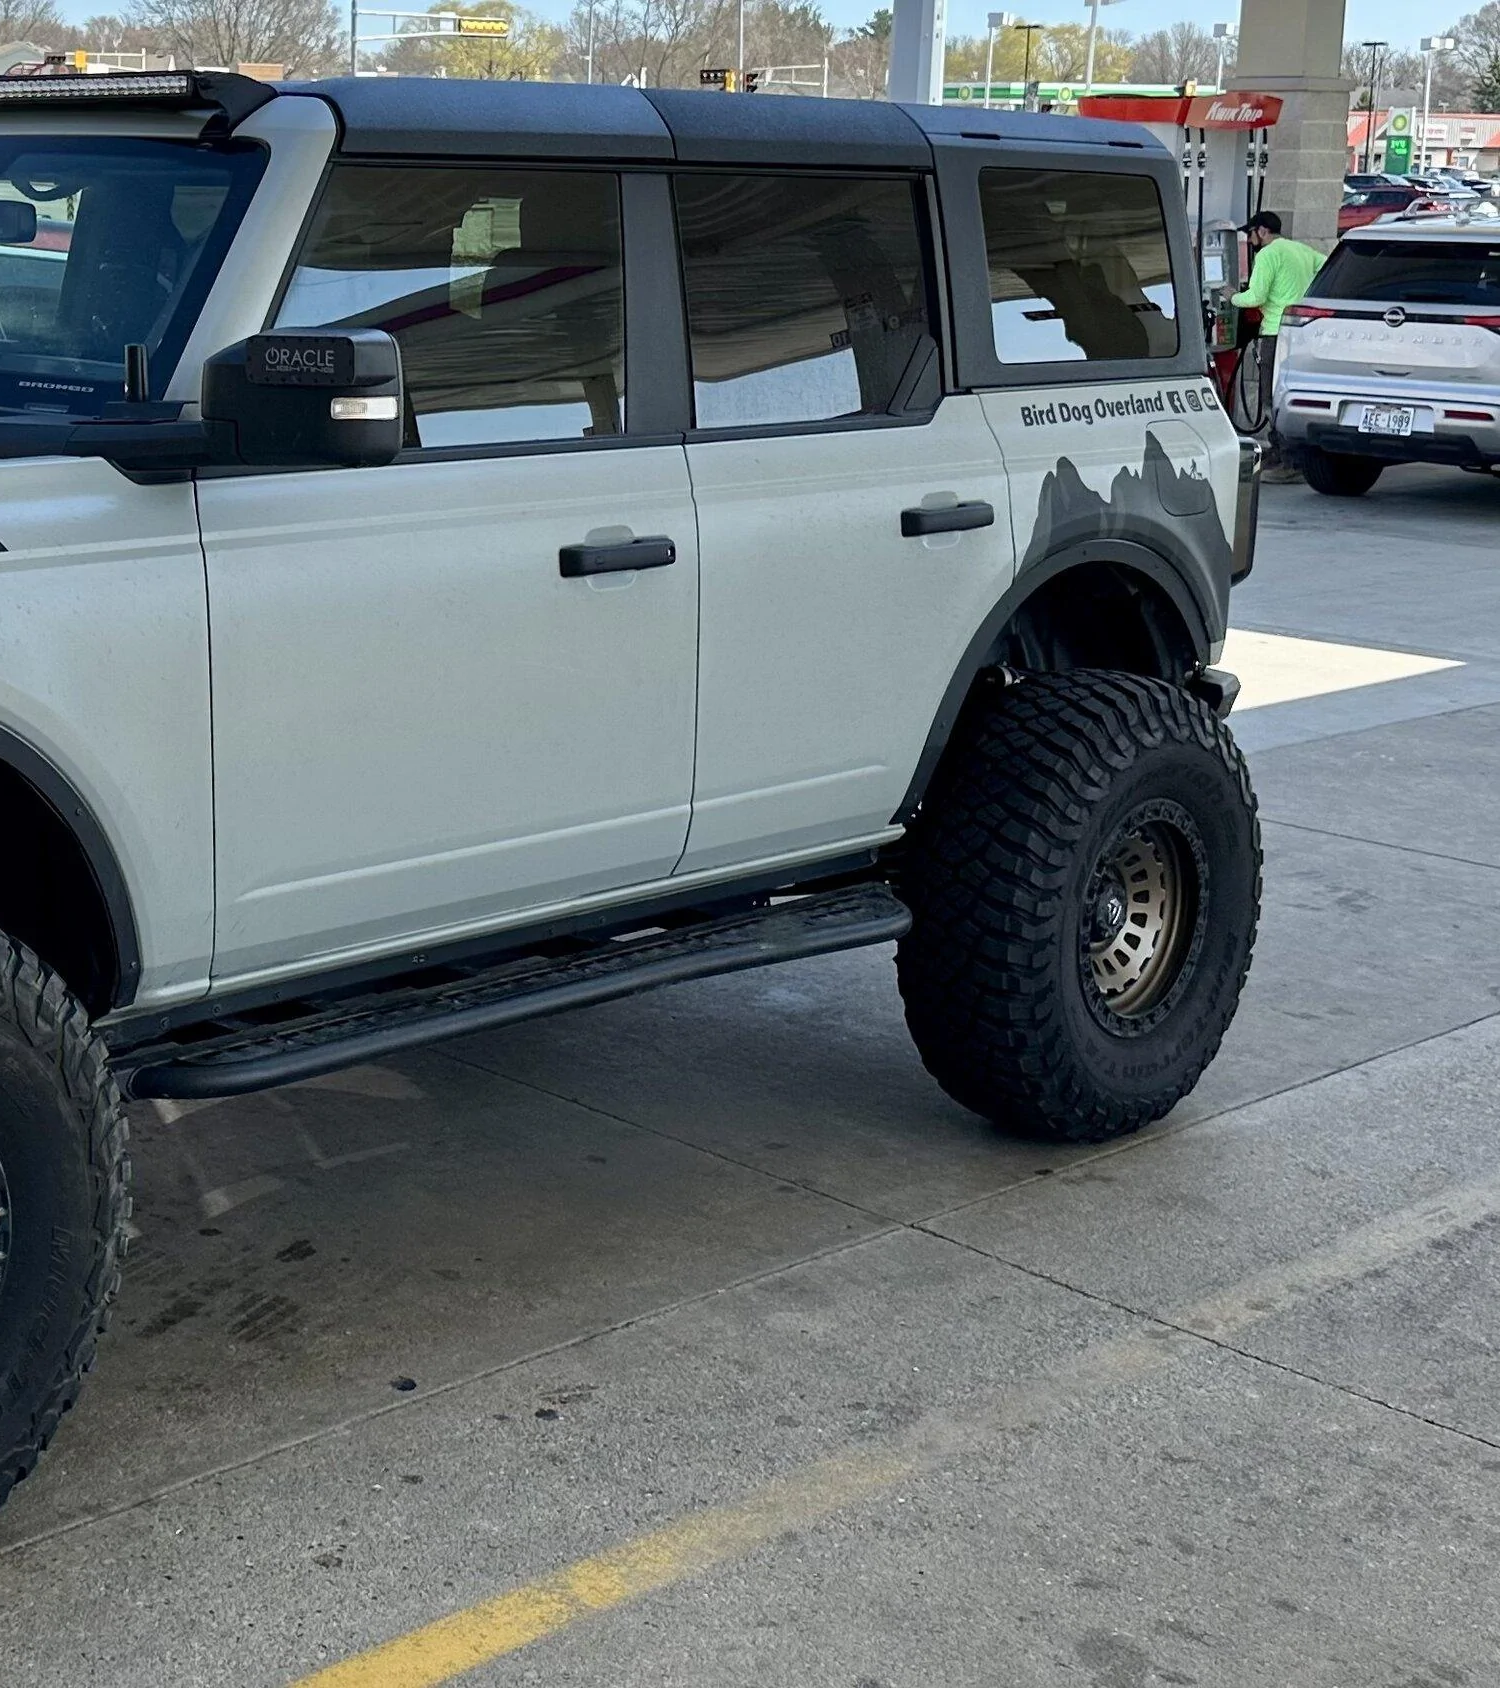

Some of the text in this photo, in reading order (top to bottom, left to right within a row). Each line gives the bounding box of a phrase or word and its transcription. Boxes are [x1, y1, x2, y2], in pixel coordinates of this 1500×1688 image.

[1314, 327, 1483, 347] PATHFINDER
[265, 347, 335, 367] ORACLE
[266, 365, 334, 373] LIGHTING
[19, 381, 94, 393] BRONCO
[1020, 391, 1165, 427] Bird Dog Overland
